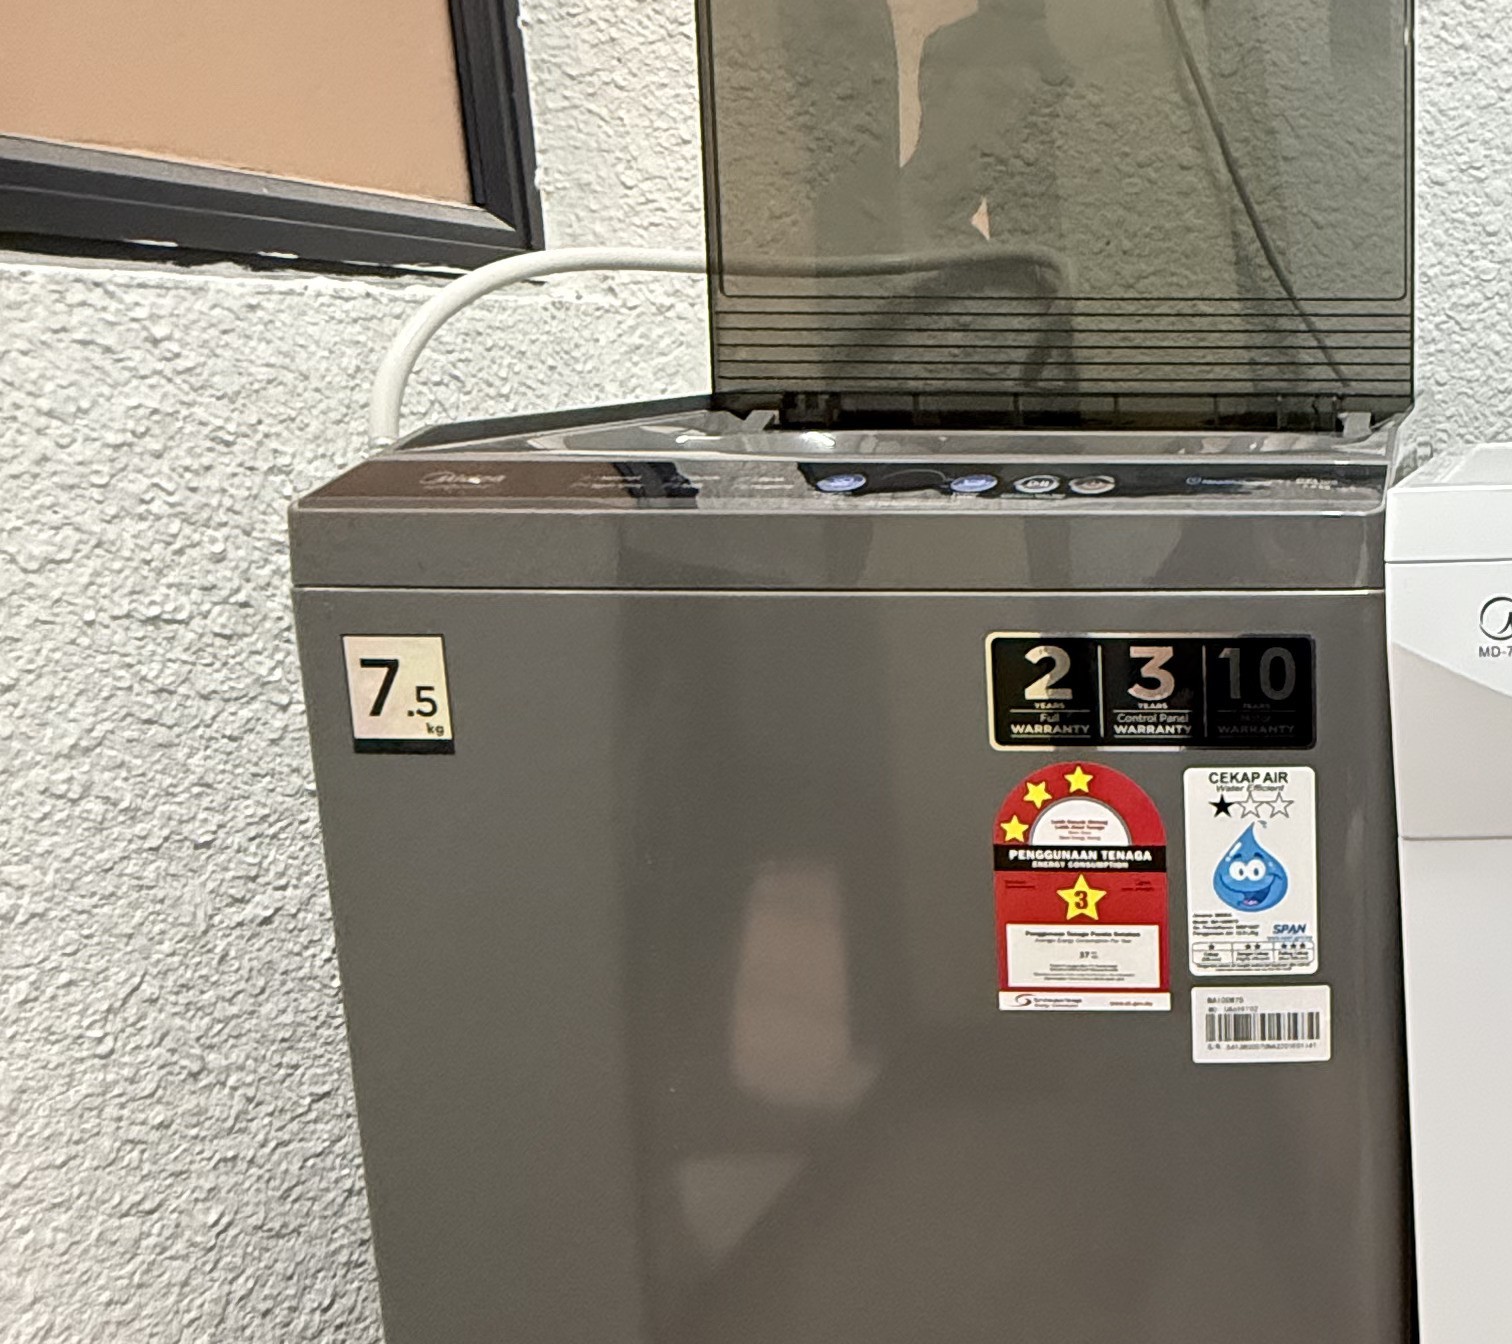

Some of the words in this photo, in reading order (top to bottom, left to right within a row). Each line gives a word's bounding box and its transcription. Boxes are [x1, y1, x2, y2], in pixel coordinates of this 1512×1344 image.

[1025, 645, 1073, 700] 2
[1127, 645, 1175, 701] 3
[1218, 646, 1296, 700] 10
[1039, 713, 1060, 722] Full
[1116, 713, 1157, 723] Control
[1158, 713, 1189, 722] Panel
[426, 722, 444, 736] kg
[1010, 724, 1090, 734] WARRANTY
[1113, 724, 1192, 734] WARRANTY
[1217, 725, 1296, 734] WARRANTY
[1208, 771, 1260, 784] CEKAP
[1263, 771, 1289, 784] AIR
[1216, 784, 1244, 792] Water
[1008, 849, 1098, 861] PENGGUNAAN
[1101, 850, 1152, 862] TENAGA
[1031, 861, 1066, 869] ENERGY
[1068, 861, 1129, 870] CONSUMPTION
[1074, 890, 1089, 909] 3
[1272, 923, 1307, 935] SPAN
